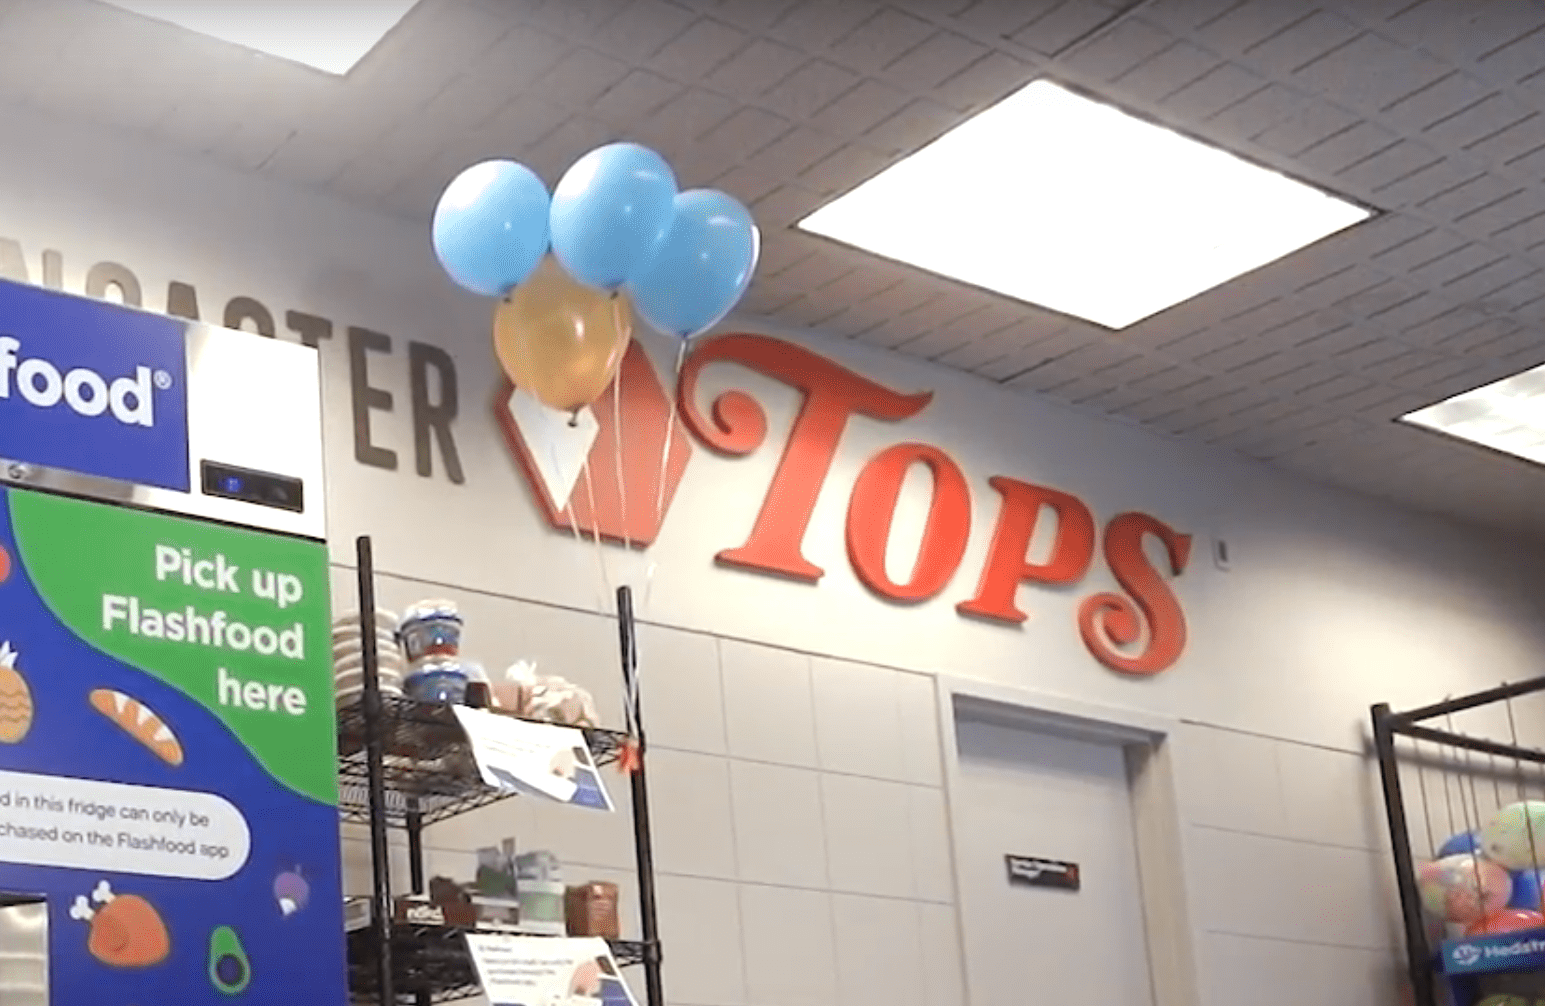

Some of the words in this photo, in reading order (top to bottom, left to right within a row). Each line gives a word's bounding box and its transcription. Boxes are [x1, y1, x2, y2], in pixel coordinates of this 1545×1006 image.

[155, 544, 239, 593] Pick
[252, 568, 303, 609] up
[102, 593, 305, 660] Flashfood
[217, 667, 307, 716] here
[15, 794, 30, 808] in
[34, 796, 64, 813] this
[68, 799, 116, 820] fridge
[119, 805, 149, 821] can
[153, 807, 186, 828] only
[189, 811, 210, 828] be
[62, 830, 83, 844] on
[87, 829, 113, 847] the
[117, 833, 195, 855] Flashfood
[200, 842, 229, 860] app
